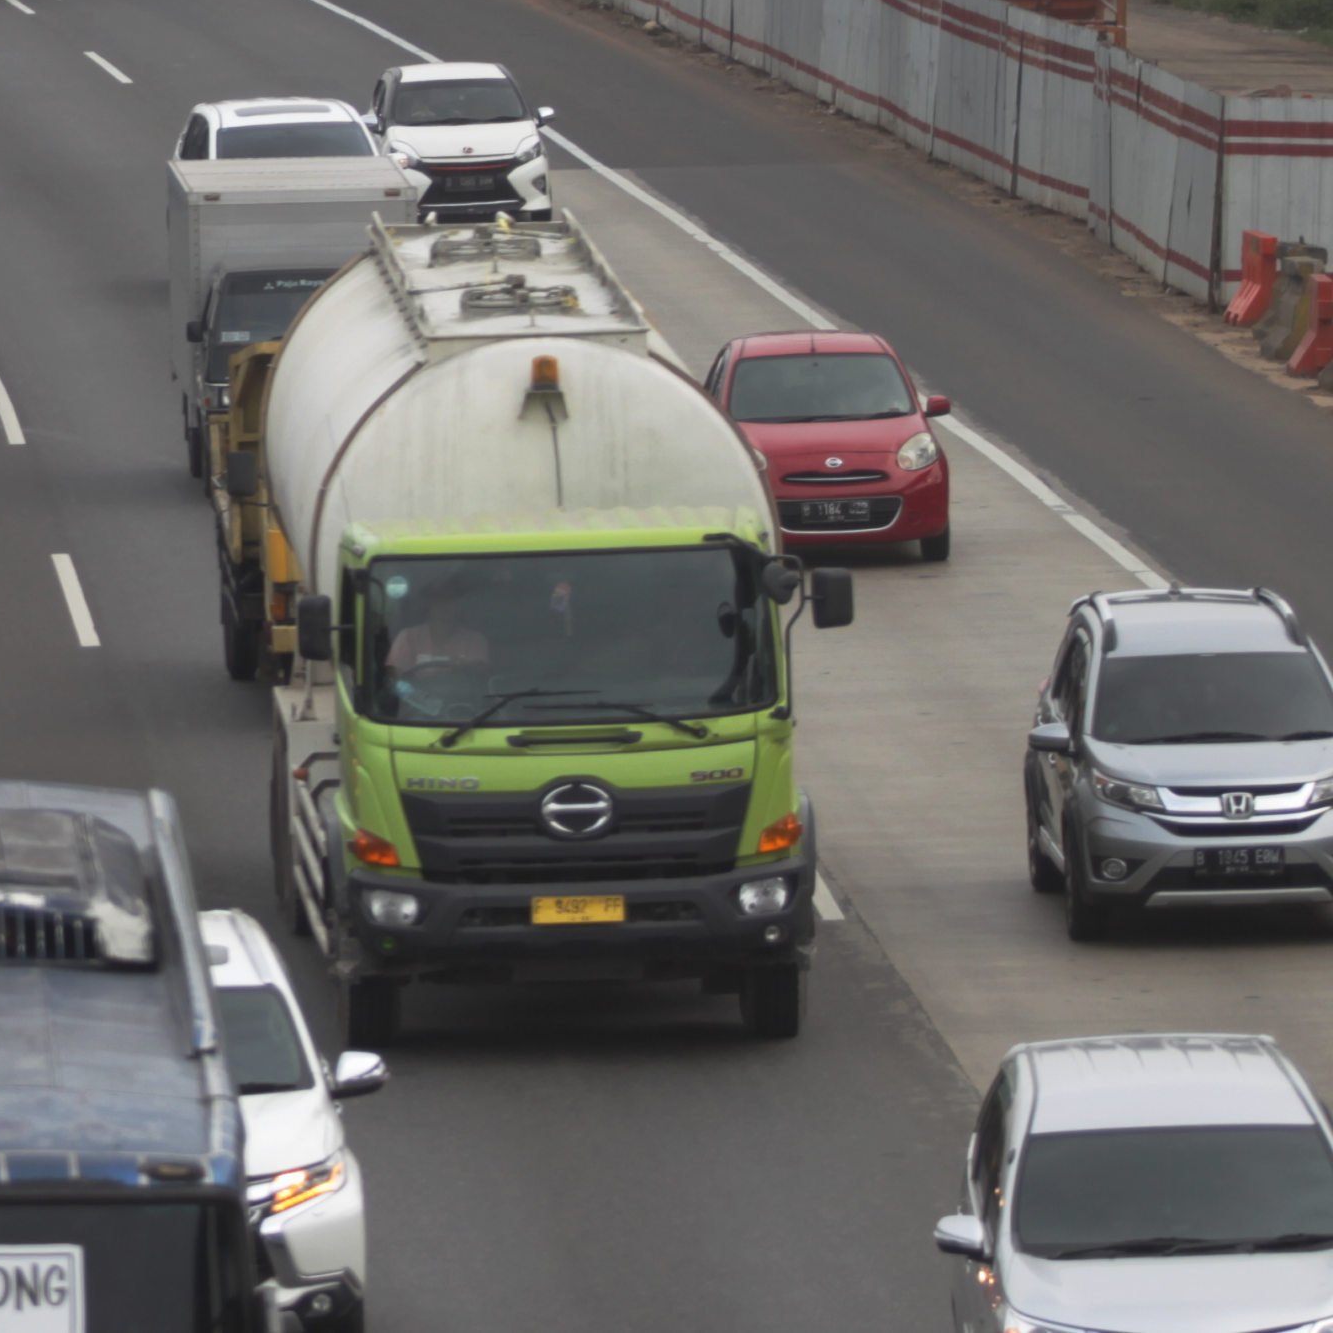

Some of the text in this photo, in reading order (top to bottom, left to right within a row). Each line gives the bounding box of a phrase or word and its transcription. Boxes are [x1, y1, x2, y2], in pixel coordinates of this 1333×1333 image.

[690, 767, 744, 782] 500
[406, 776, 480, 790] HINO
[1196, 850, 1205, 866] B
